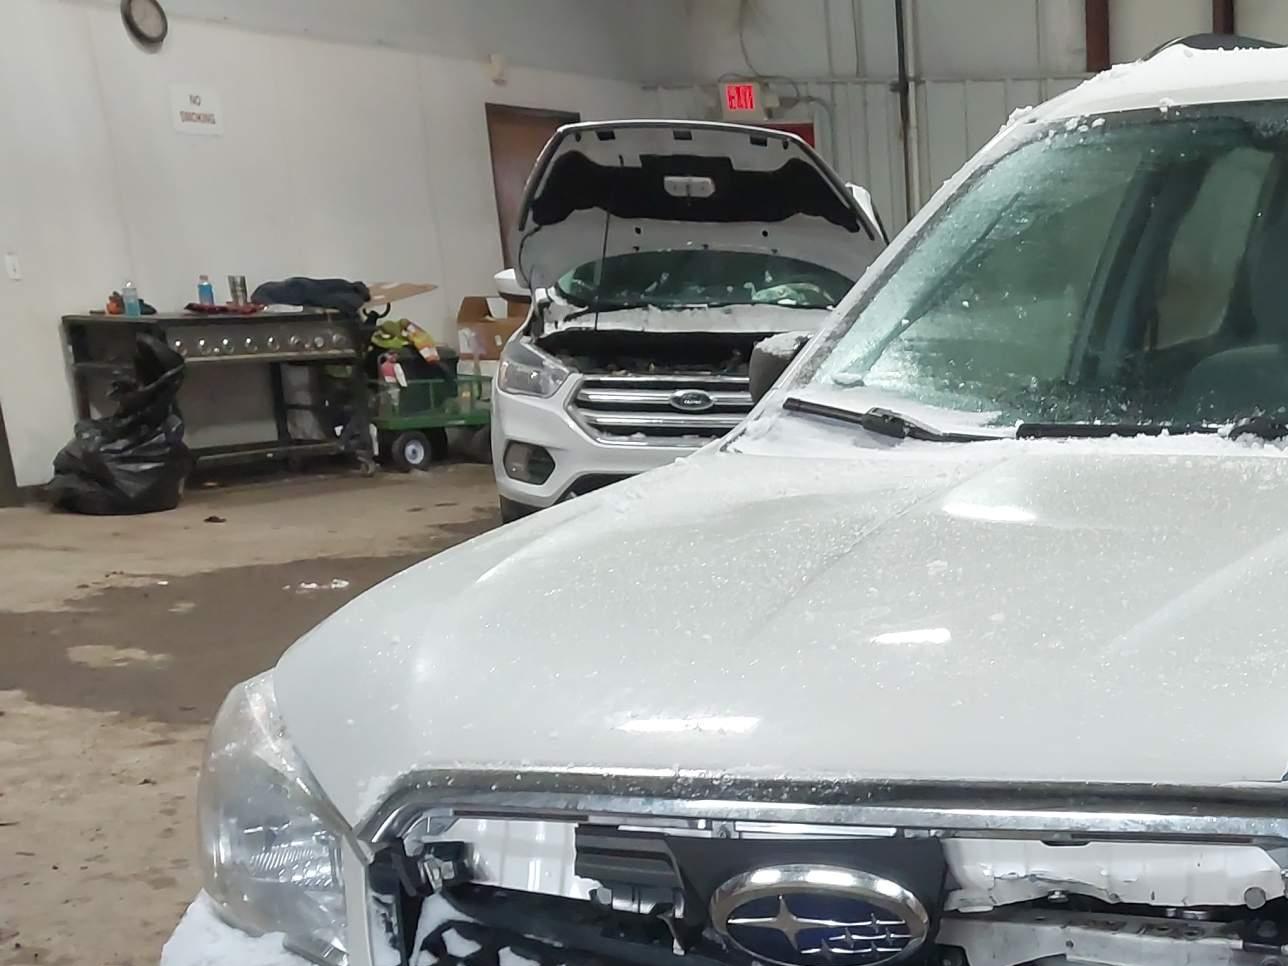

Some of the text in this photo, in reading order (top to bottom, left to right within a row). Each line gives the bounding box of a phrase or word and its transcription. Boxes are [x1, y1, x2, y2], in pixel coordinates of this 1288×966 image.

[189, 95, 201, 106] NO
[727, 84, 754, 110] EXIT
[179, 111, 216, 124] SMOKING
